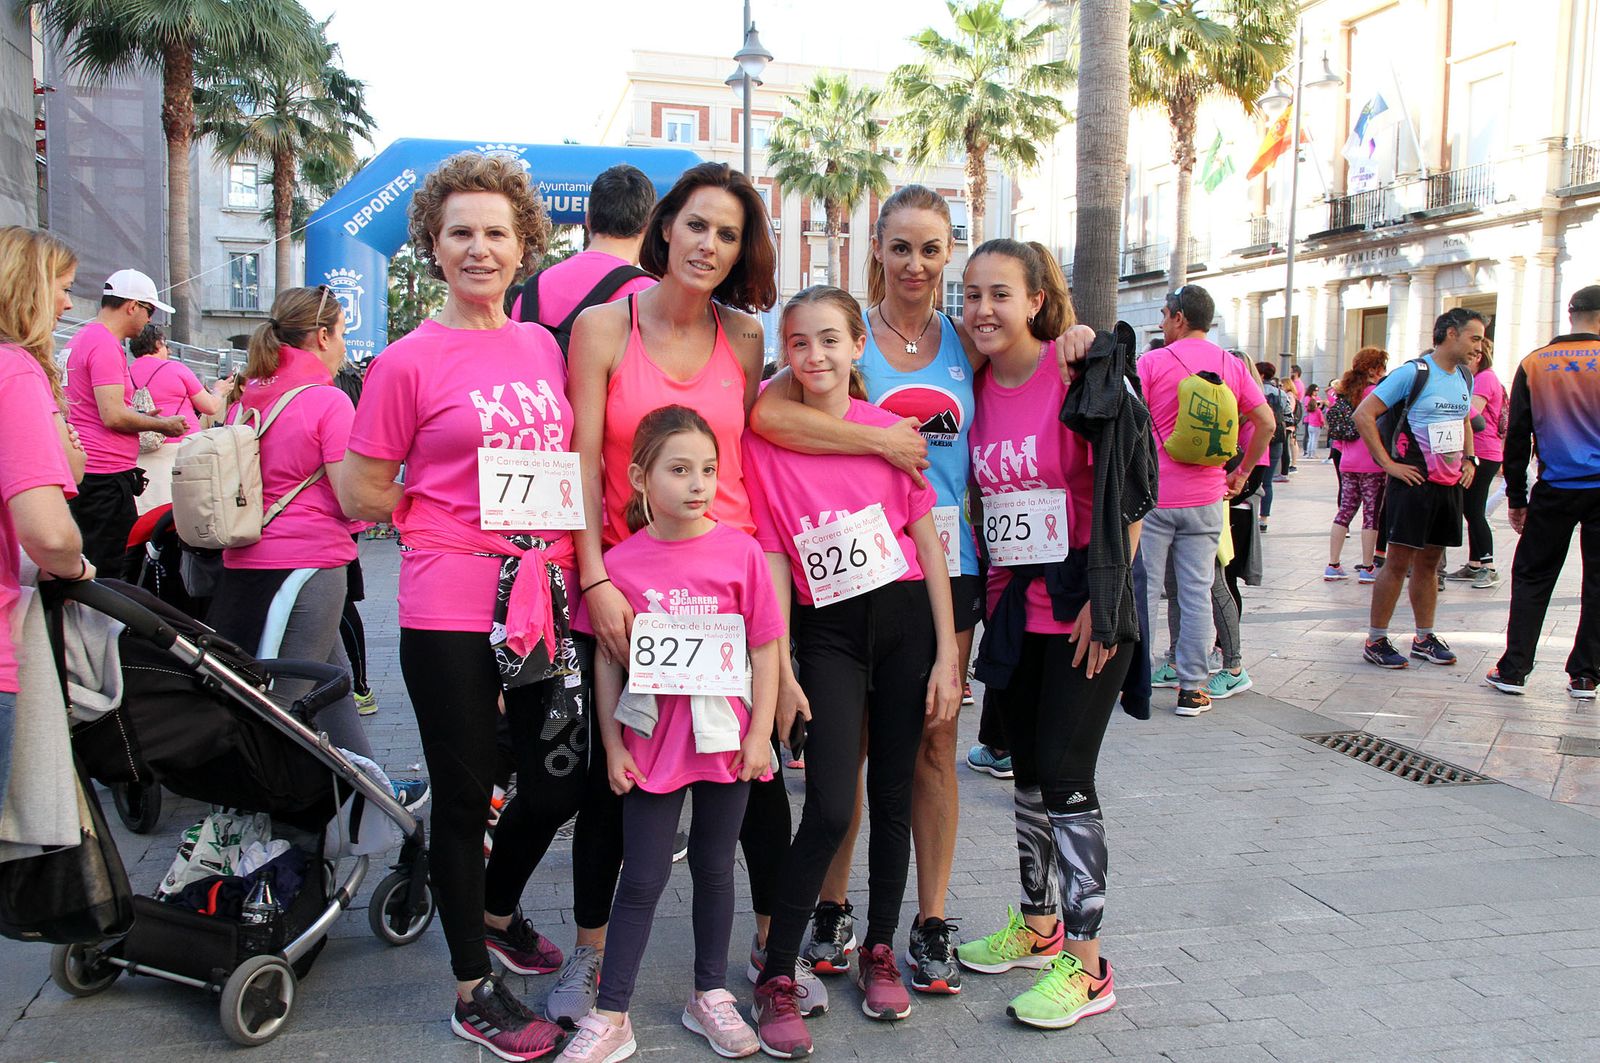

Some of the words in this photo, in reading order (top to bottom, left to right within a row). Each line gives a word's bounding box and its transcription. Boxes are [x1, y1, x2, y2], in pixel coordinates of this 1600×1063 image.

[344, 169, 417, 236] DEPORTES
[366, 339, 375, 347] de
[346, 349, 373, 362] VA
[469, 380, 562, 432] KM
[930, 440, 953, 448] HUELVA
[1436, 431, 1453, 444] 74
[496, 456, 529, 467] Carrera
[531, 459, 541, 468] de
[543, 459, 550, 468] la
[552, 460, 576, 470] Mujer
[973, 435, 1038, 484] KM
[496, 473, 535, 504] 77
[993, 501, 1015, 510] Carrera
[1016, 499, 1026, 507] de
[1028, 498, 1036, 506] la
[1038, 496, 1061, 506] Mujer
[934, 514, 955, 522] Mujer
[811, 530, 842, 545] Carrera
[843, 525, 854, 535] de
[854, 521, 862, 530] la
[986, 513, 1031, 543] 825
[807, 538, 867, 581] 826
[681, 596, 718, 605] CARRERA
[680, 605, 718, 616] MUJER
[651, 619, 686, 630] Carrera
[688, 621, 700, 631] de
[703, 622, 711, 631] la
[713, 622, 740, 633] Mujer
[635, 635, 704, 668] 827
